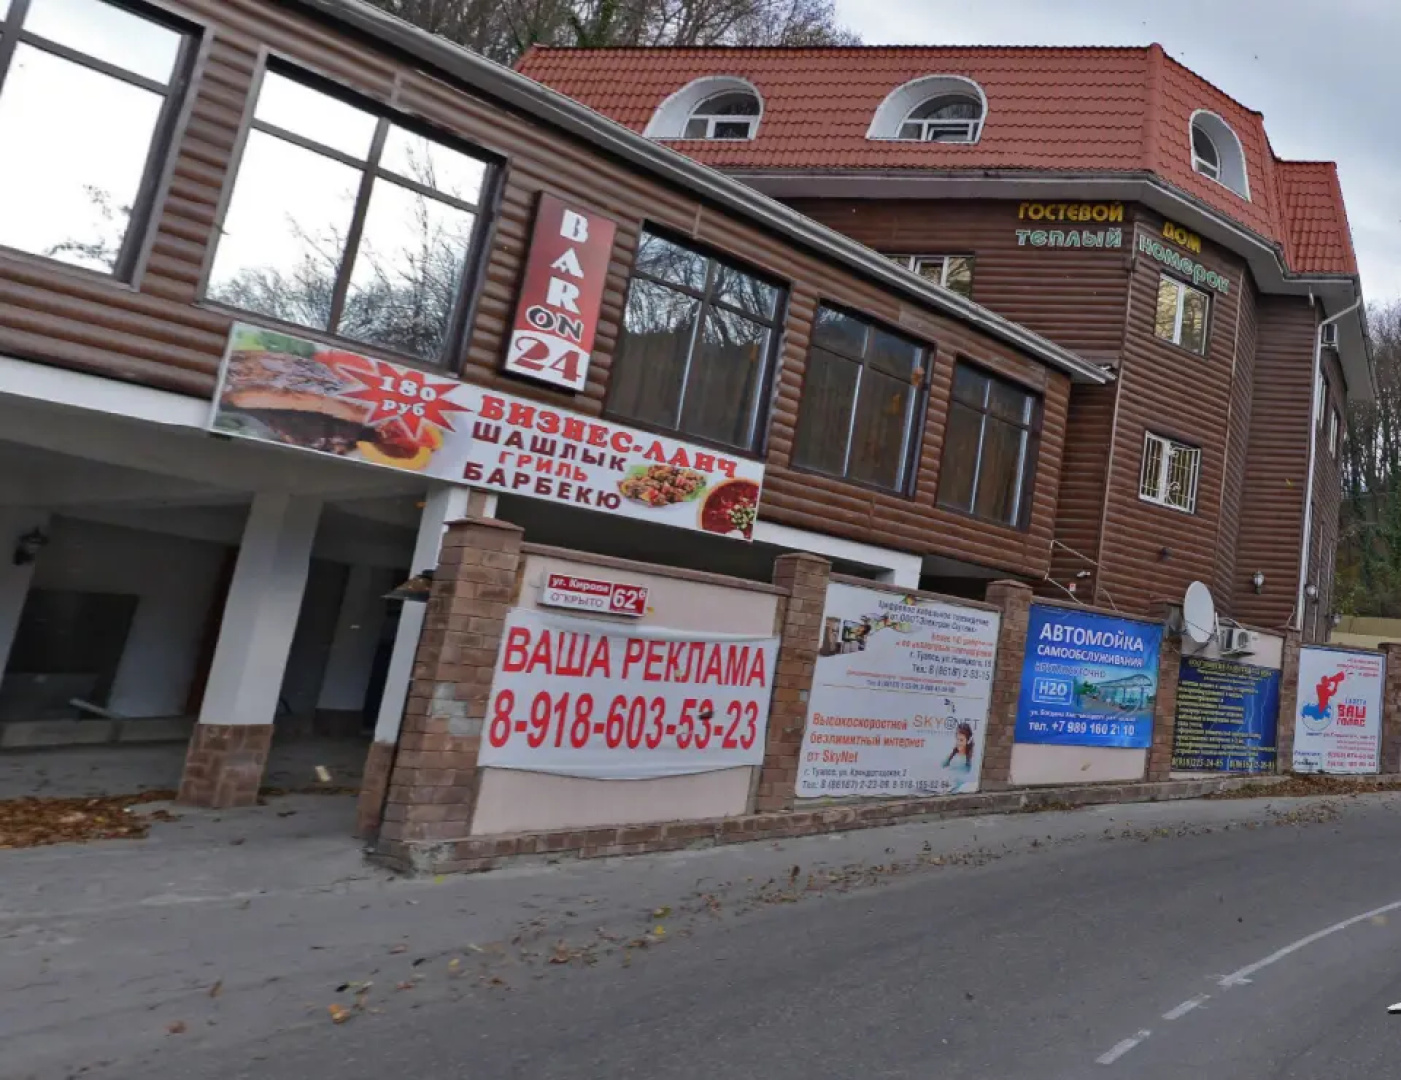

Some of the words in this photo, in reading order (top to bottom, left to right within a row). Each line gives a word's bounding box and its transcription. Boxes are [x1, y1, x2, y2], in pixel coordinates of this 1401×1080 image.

[1018, 202, 1123, 223] ГОСТЕВОЙ
[1162, 221, 1202, 253] ДОМ
[513, 336, 583, 382] 24
[379, 376, 437, 402] 180
[381, 399, 426, 417] руб
[472, 421, 628, 473] ШАШЛЫК
[478, 394, 738, 478] БИЗНЕС-ЛАНЧ
[498, 450, 589, 483] ГРИЛЬ
[462, 461, 621, 510] БАРБЕКЮ
[568, 578, 610, 593] Кирова
[1039, 622, 1144, 652] АВТОМОЙКА
[502, 625, 612, 679] ВАША
[621, 637, 766, 688] РЕКЛАМА
[1037, 644, 1144, 668] САМООБСЛУЖИВАНИЯ
[1038, 681, 1068, 696] H2O
[489, 689, 760, 750] 8-918-603-53-23
[1337, 704, 1367, 718] ВАШ
[809, 731, 881, 746] безлимитный
[883, 737, 926, 750] интернет
[1029, 721, 1049, 732] тел.
[1051, 720, 1066, 732] +7
[1067, 722, 1087, 734] 989
[1123, 725, 1135, 735] 10
